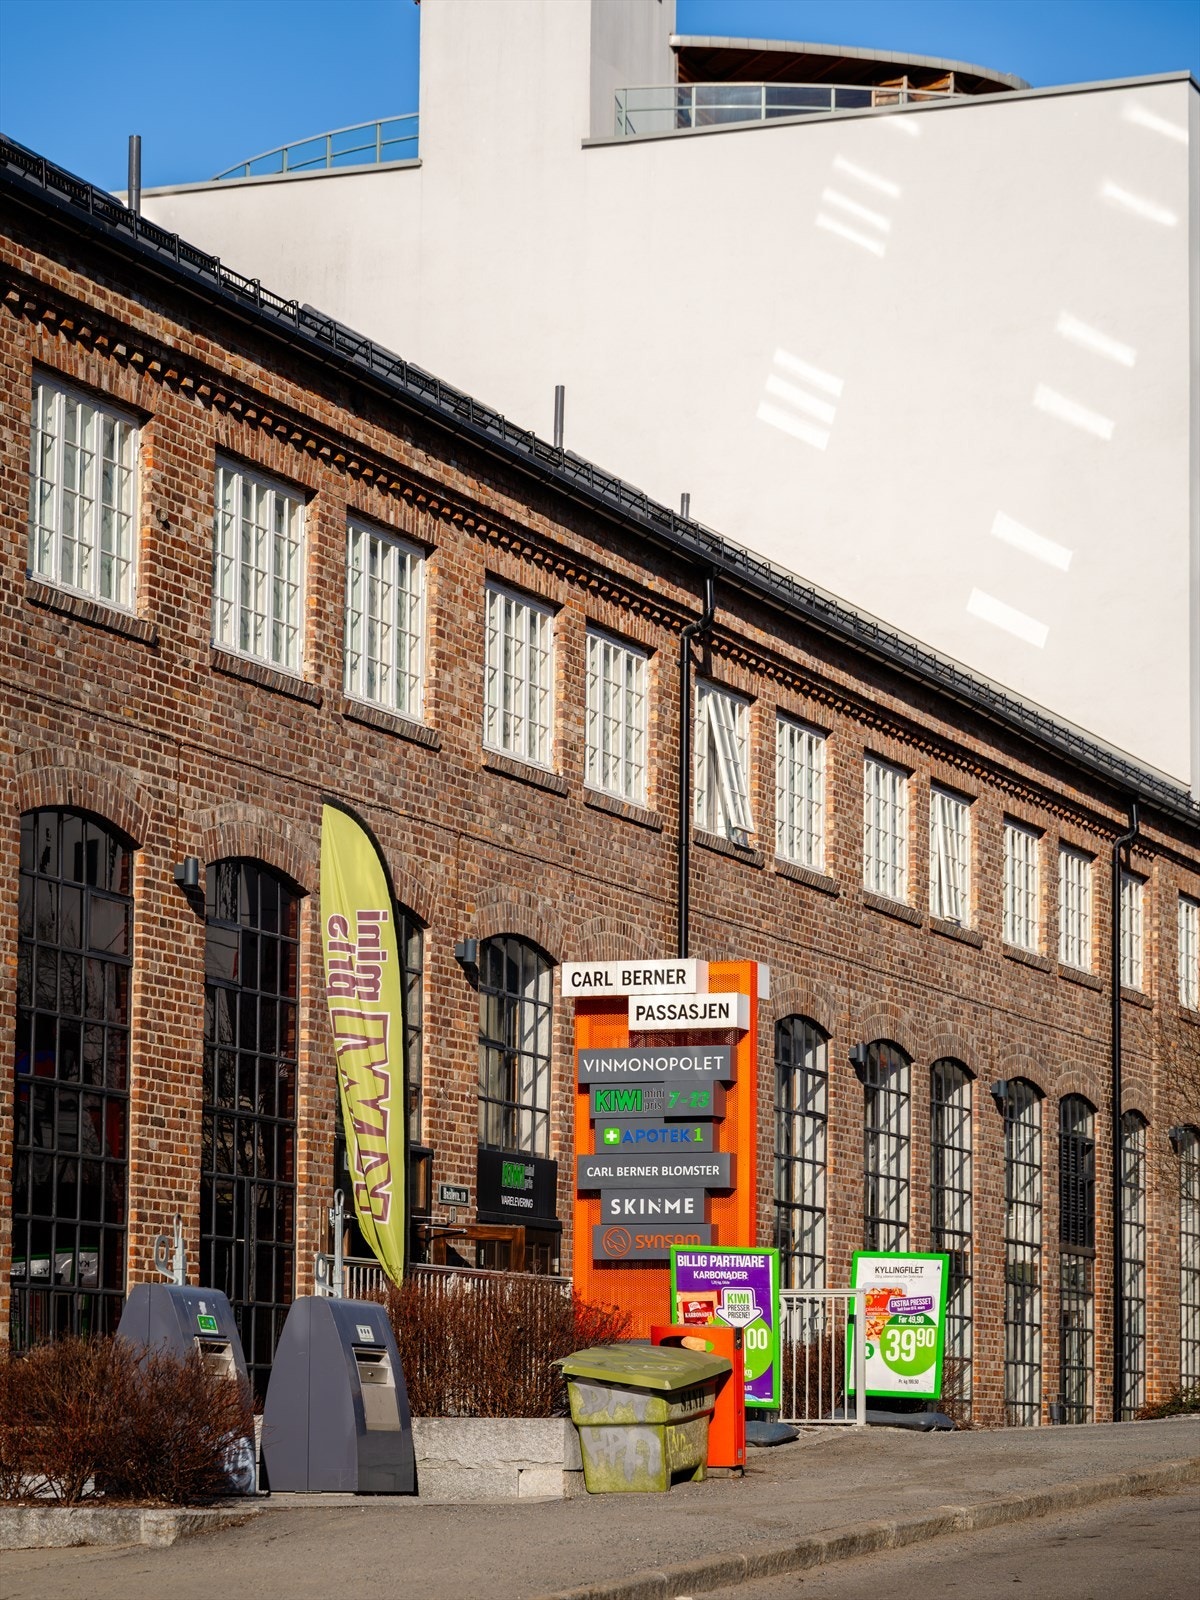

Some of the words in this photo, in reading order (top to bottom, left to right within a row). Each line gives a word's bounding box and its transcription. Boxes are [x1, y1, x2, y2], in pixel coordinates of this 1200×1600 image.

[571, 971, 613, 987] CARL
[621, 968, 687, 986] BERNER
[635, 1003, 730, 1021] PASSASJEN
[583, 1056, 724, 1073] VINMONOPOLET
[644, 1088, 665, 1099] mini
[595, 1089, 643, 1112] KIWI
[644, 1099, 662, 1112] pris
[622, 1128, 692, 1144] APOTEK
[586, 1166, 614, 1177] CARL
[616, 1165, 659, 1176] BERNER
[661, 1164, 720, 1176] BLOMSTER
[501, 1196, 534, 1208] VARELEVERING
[677, 1254, 708, 1268] BILLIG
[709, 1255, 765, 1268] PARTIVARE
[693, 1270, 748, 1280] KARBONADER
[727, 1293, 750, 1303] KIWI
[891, 1299, 910, 1308] EKSTRA
[910, 1297, 932, 1307] PRESSET
[727, 1304, 750, 1312] PRESSER
[727, 1311, 751, 1319] PRISENE!
[908, 1316, 924, 1324] 49,90
[681, 1386, 706, 1412] SAND
